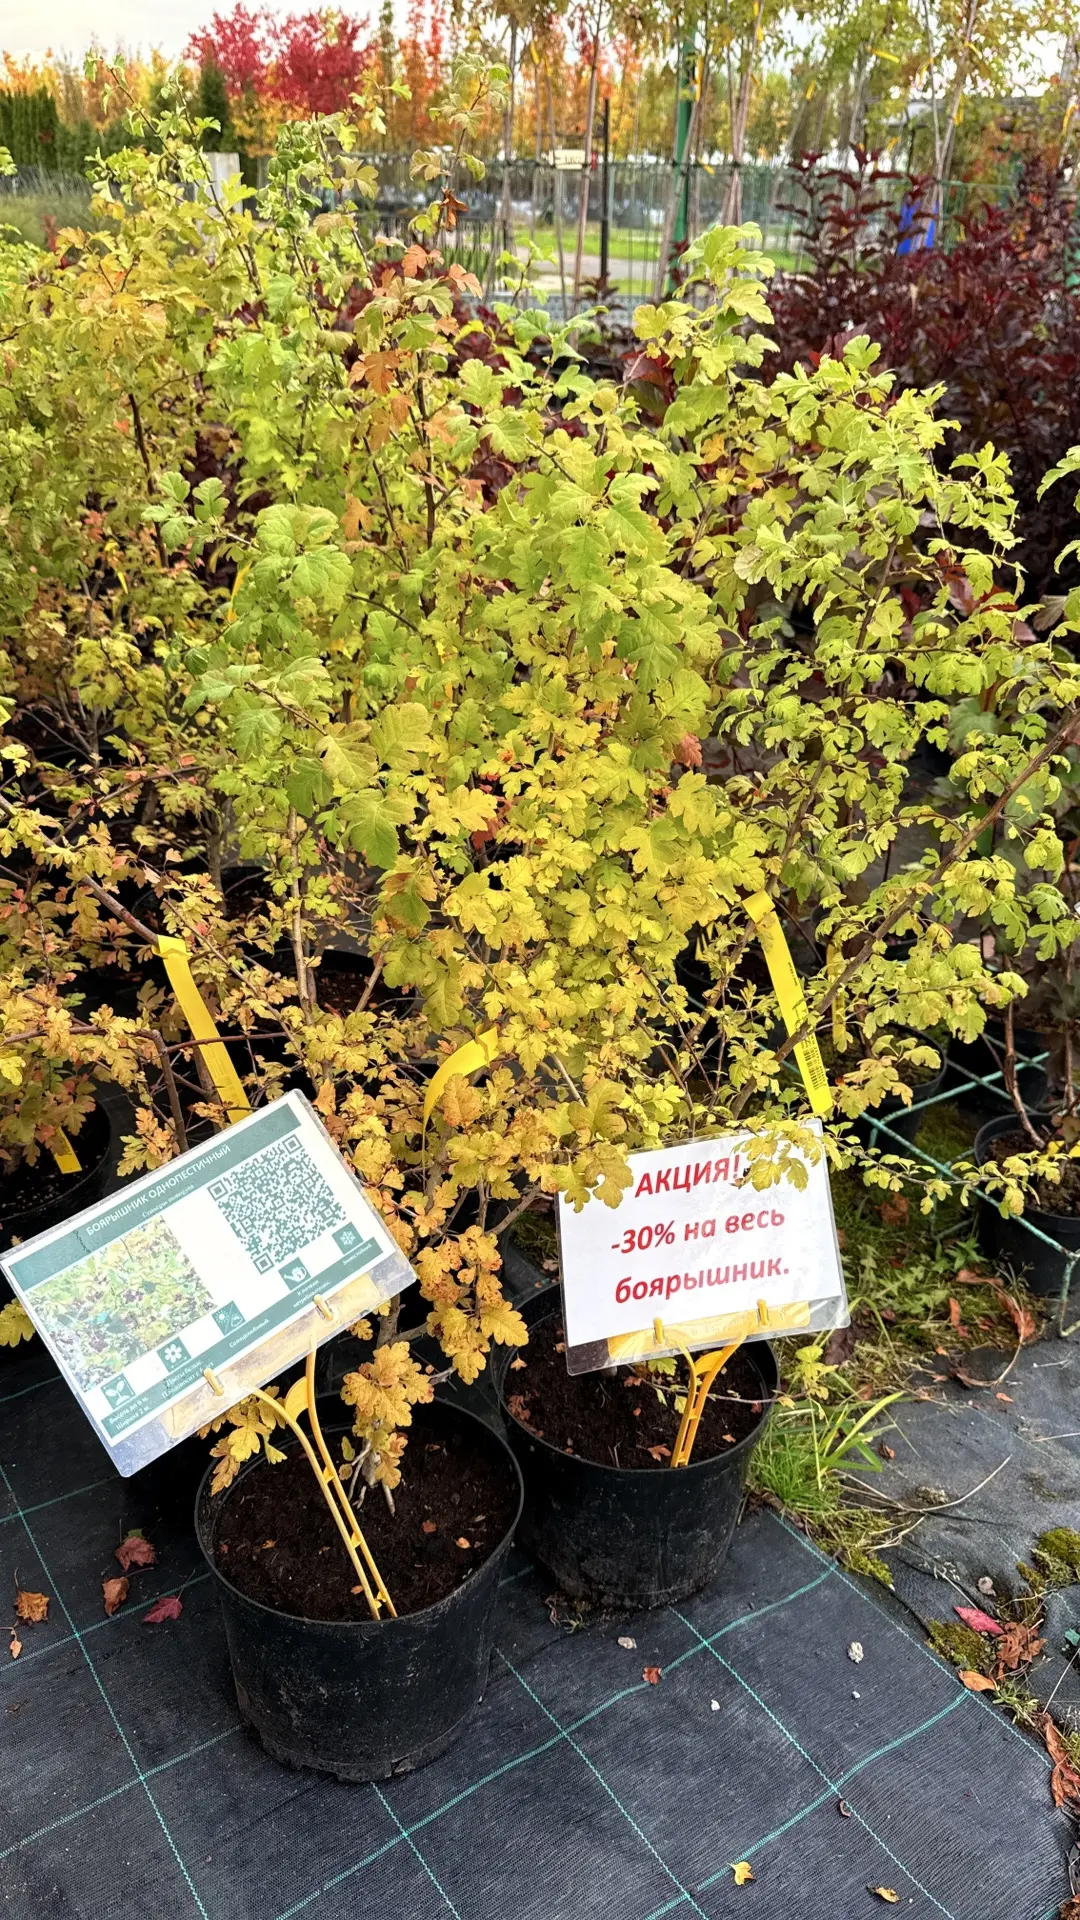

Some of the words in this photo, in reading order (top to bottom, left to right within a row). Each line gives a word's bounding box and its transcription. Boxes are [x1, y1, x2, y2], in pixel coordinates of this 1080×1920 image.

[86, 1194, 149, 1236] БОЯРЫШНИК
[149, 1143, 231, 1198] ОДНОПЕСТИЧНЫЙ
[634, 1154, 741, 1198] АКЦИЯ!
[611, 1220, 676, 1255] -30%
[684, 1217, 717, 1242] на
[724, 1208, 785, 1235] весь
[615, 1257, 790, 1304] боярышник.
